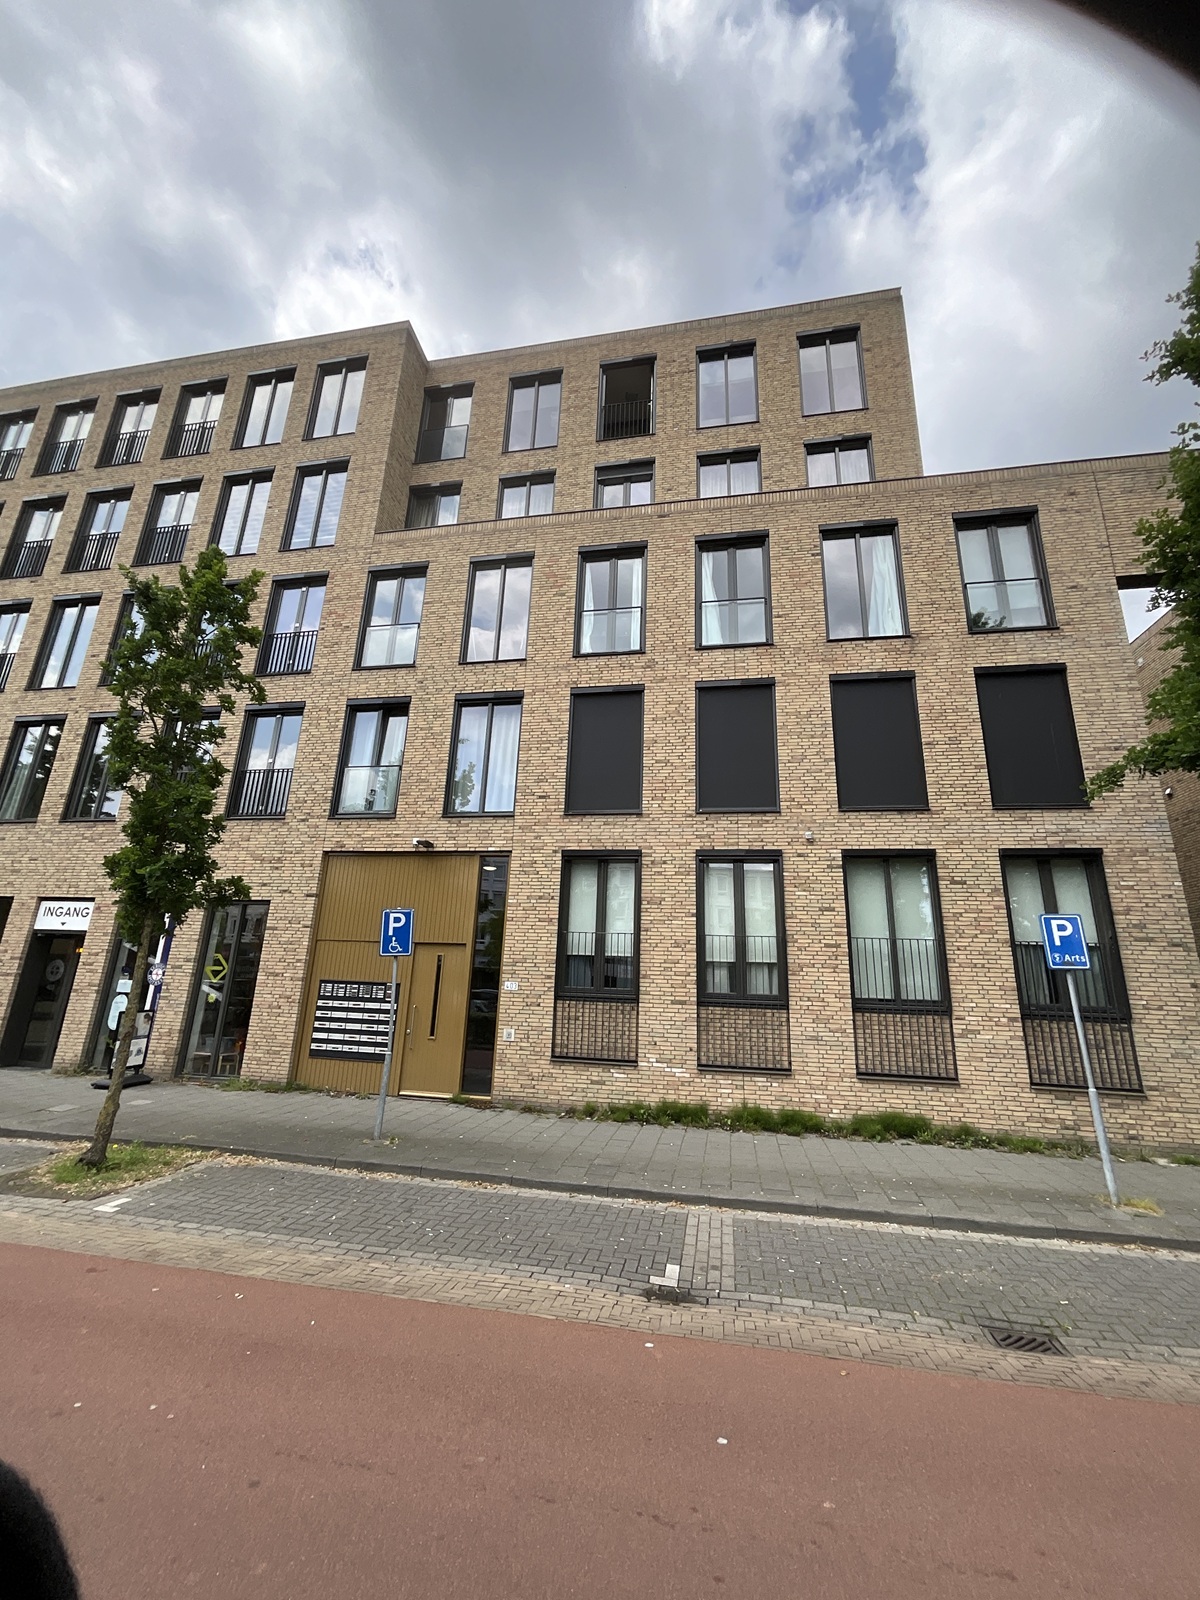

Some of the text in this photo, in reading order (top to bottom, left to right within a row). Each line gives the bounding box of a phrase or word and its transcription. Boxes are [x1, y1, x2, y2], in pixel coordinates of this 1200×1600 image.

[43, 906, 90, 918] INGANG
[388, 912, 406, 936] P
[1050, 919, 1073, 946] P
[1064, 954, 1086, 963] Arts
